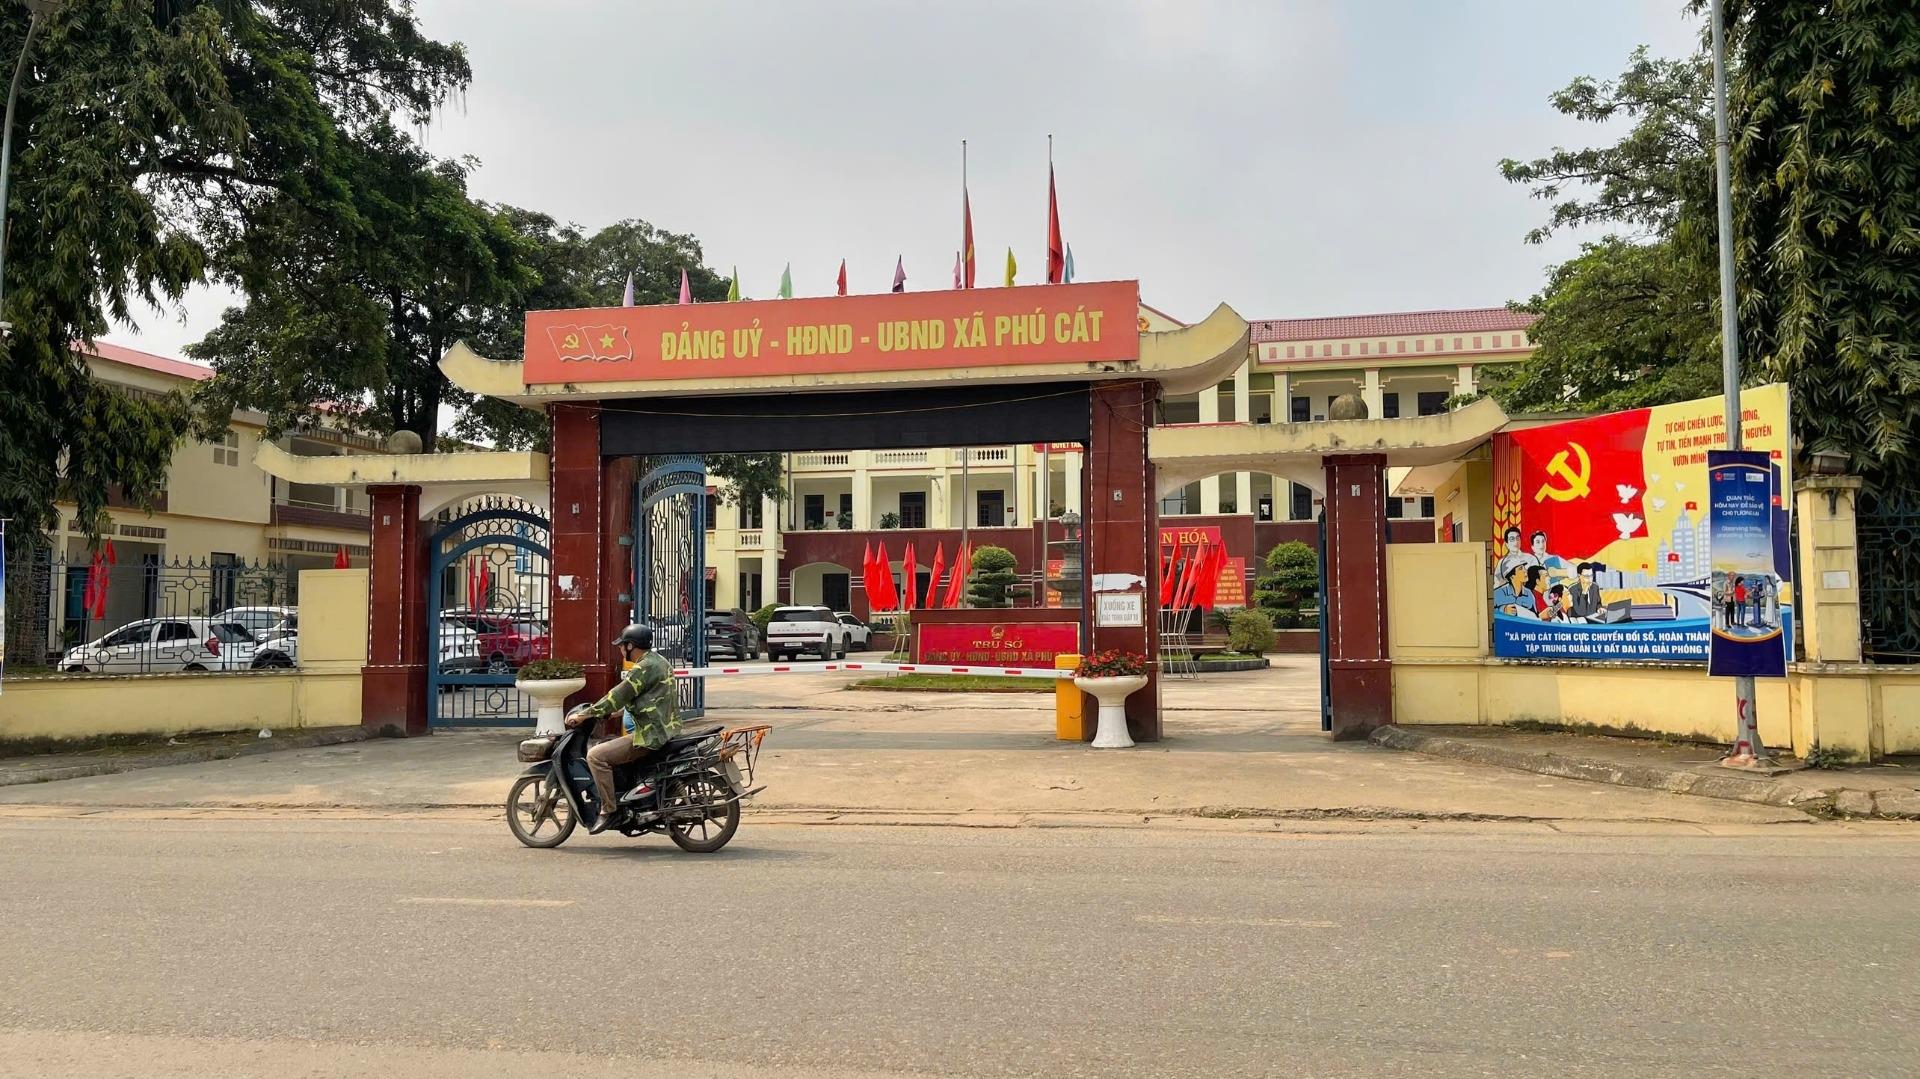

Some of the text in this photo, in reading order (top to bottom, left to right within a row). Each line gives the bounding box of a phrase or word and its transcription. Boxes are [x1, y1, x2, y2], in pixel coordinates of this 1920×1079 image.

[661, 305, 1104, 361] ĐẢNG UỶ - HĐND - UBND XÃ PHÚ CÁT
[1665, 421, 1673, 435] TỰ
[1740, 408, 1760, 422] ƯỜNG,
[1745, 424, 1772, 439] NGUYÊN
[1178, 527, 1209, 544] HÓA
[1538, 631, 1552, 641] CÁT
[1554, 631, 1572, 641] TÍCH
[1573, 632, 1590, 643] CỰC
[1591, 630, 1624, 641] CHUYỂN
[1659, 631, 1683, 641] HOÀN
[1685, 631, 1710, 641] THÀN
[1541, 644, 1567, 653] TRUNG
[1568, 642, 1591, 653] QUẢN
[1592, 643, 1602, 653] LÝ
[1604, 642, 1620, 653] ĐẤT
[1621, 644, 1637, 654] ĐAI
[1638, 643, 1650, 654] VÀ
[1651, 642, 1670, 654] GIẢI
[1671, 643, 1702, 654] PHÓNG
